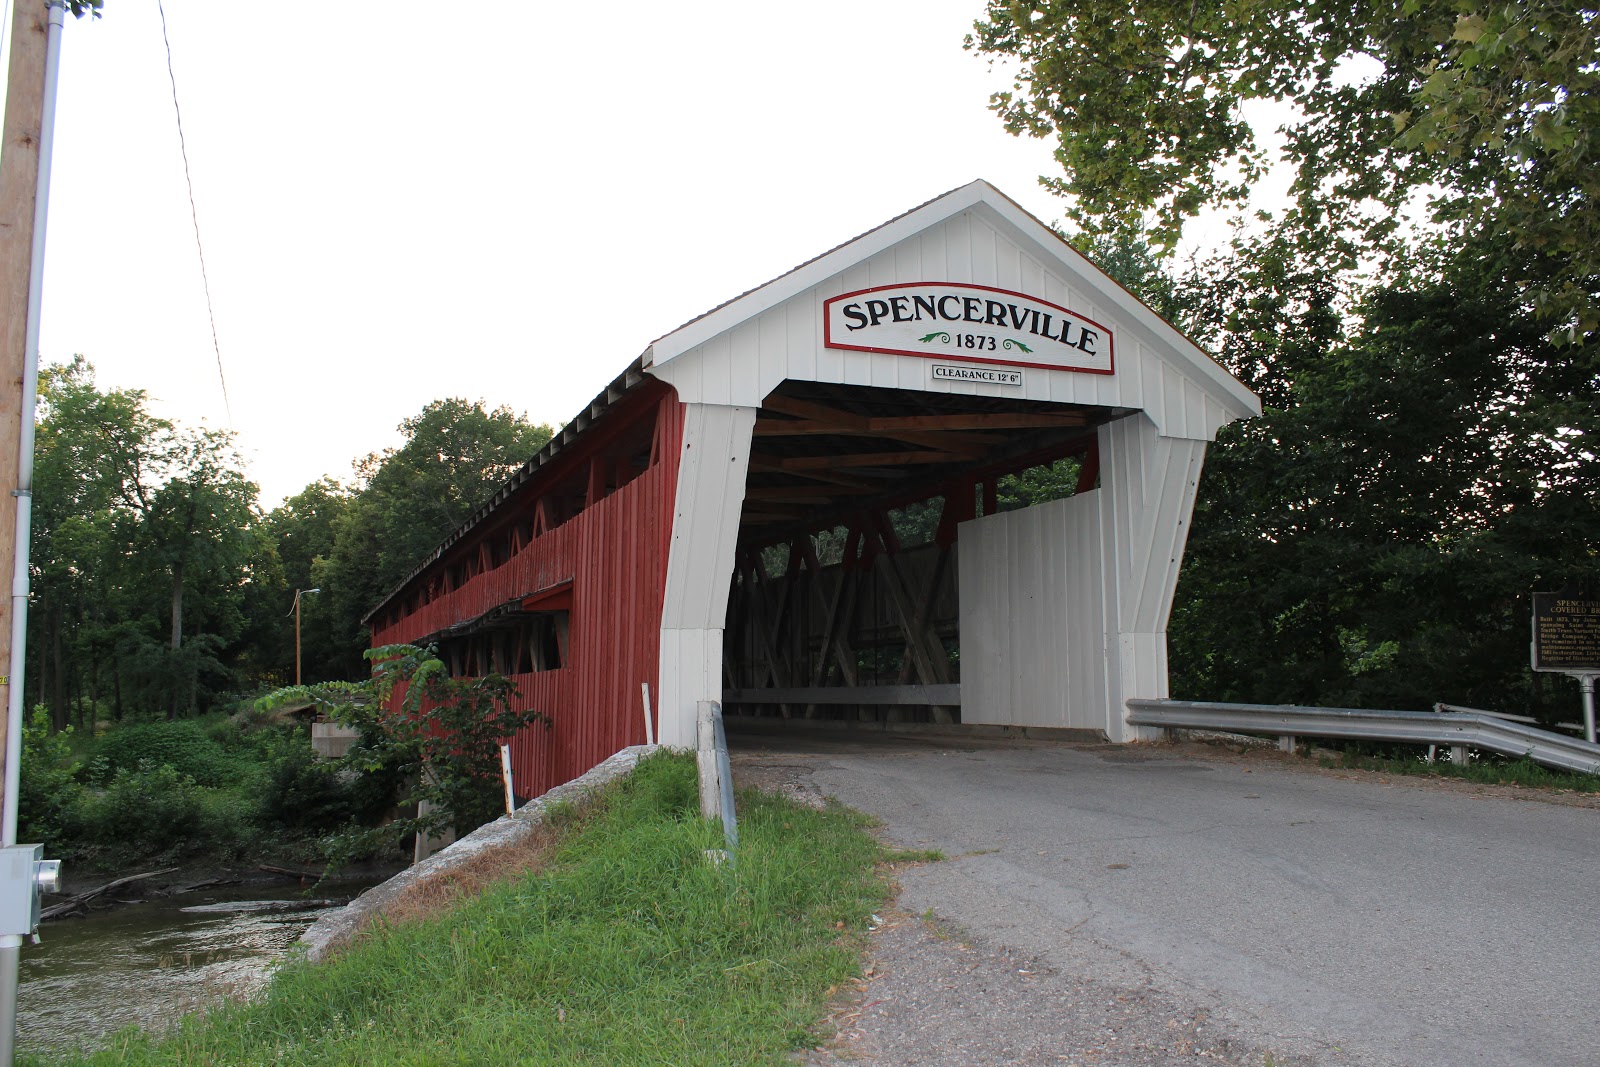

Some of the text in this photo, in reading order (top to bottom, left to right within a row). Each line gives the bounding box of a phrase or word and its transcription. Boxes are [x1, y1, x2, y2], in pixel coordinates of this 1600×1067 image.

[842, 295, 1099, 356] SPENCERVILLE
[956, 333, 997, 351] 1873
[936, 368, 995, 381] CLEARANCE
